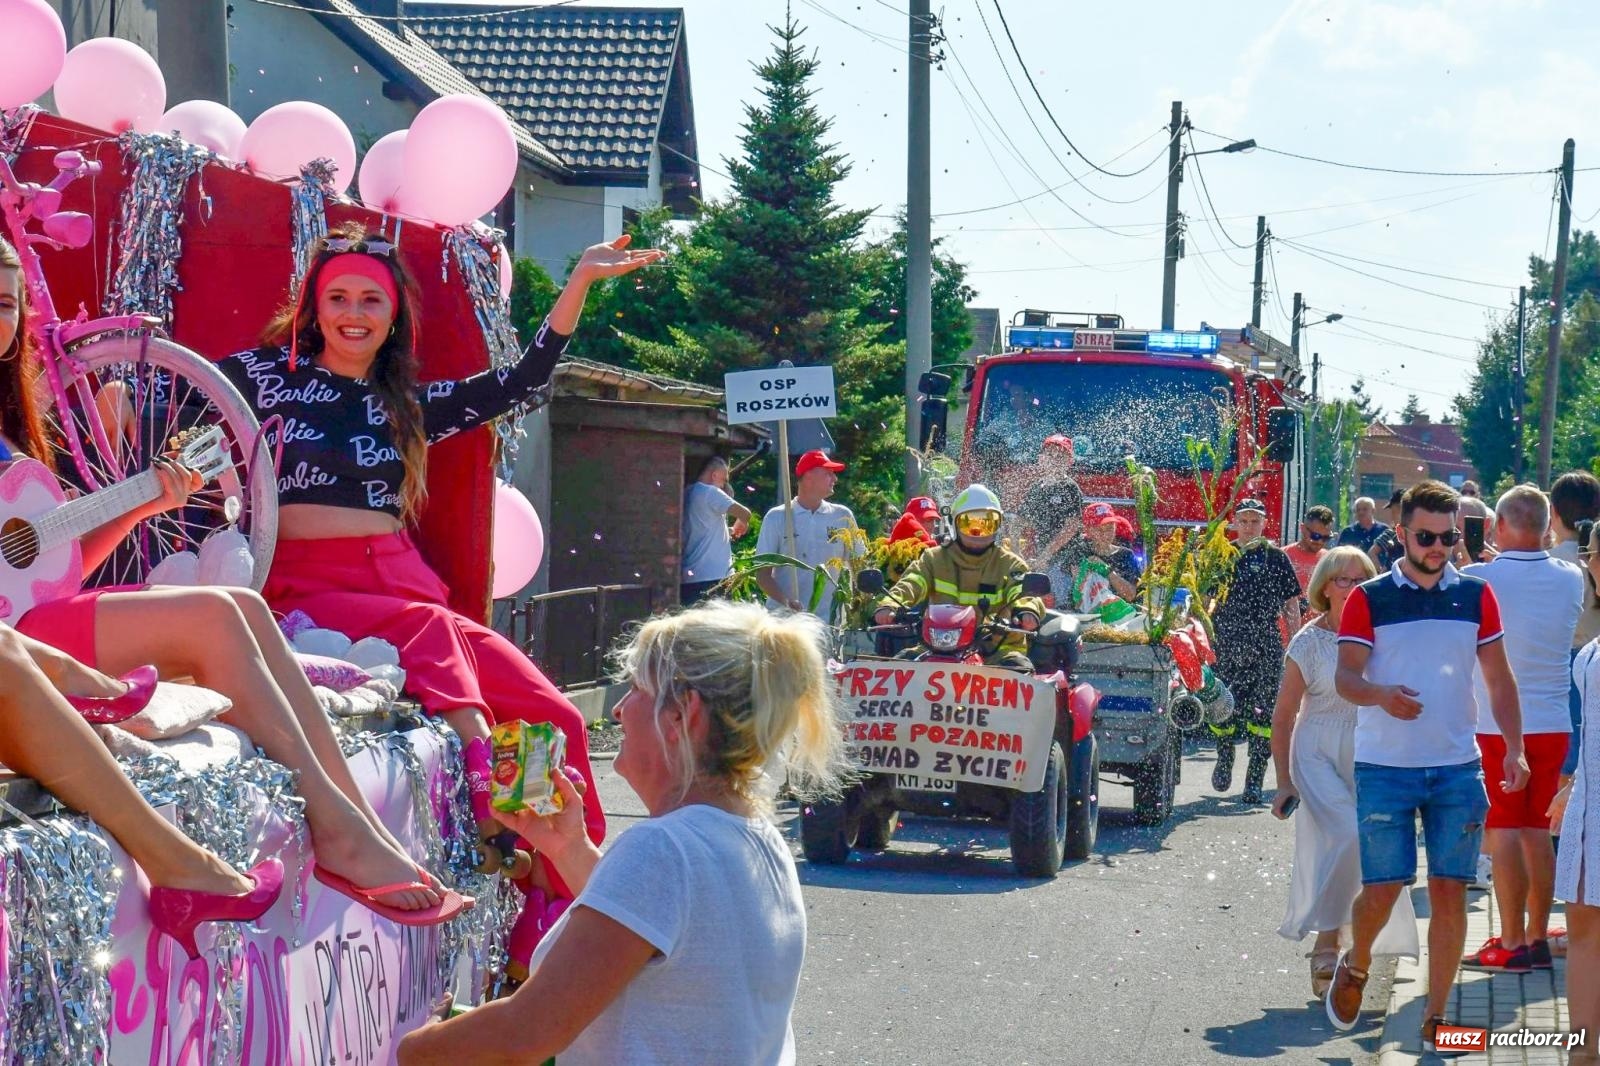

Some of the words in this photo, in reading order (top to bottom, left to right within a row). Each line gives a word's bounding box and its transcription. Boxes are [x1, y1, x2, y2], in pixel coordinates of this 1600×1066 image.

[257, 374, 342, 409] Barbie
[759, 378, 797, 391] OSP
[736, 393, 830, 413] ROSZKÓW
[349, 435, 402, 467] Bar
[277, 461, 338, 493] arbie
[833, 667, 915, 698] TRZY
[855, 699, 914, 718] SERCA
[929, 702, 990, 727] BICIE
